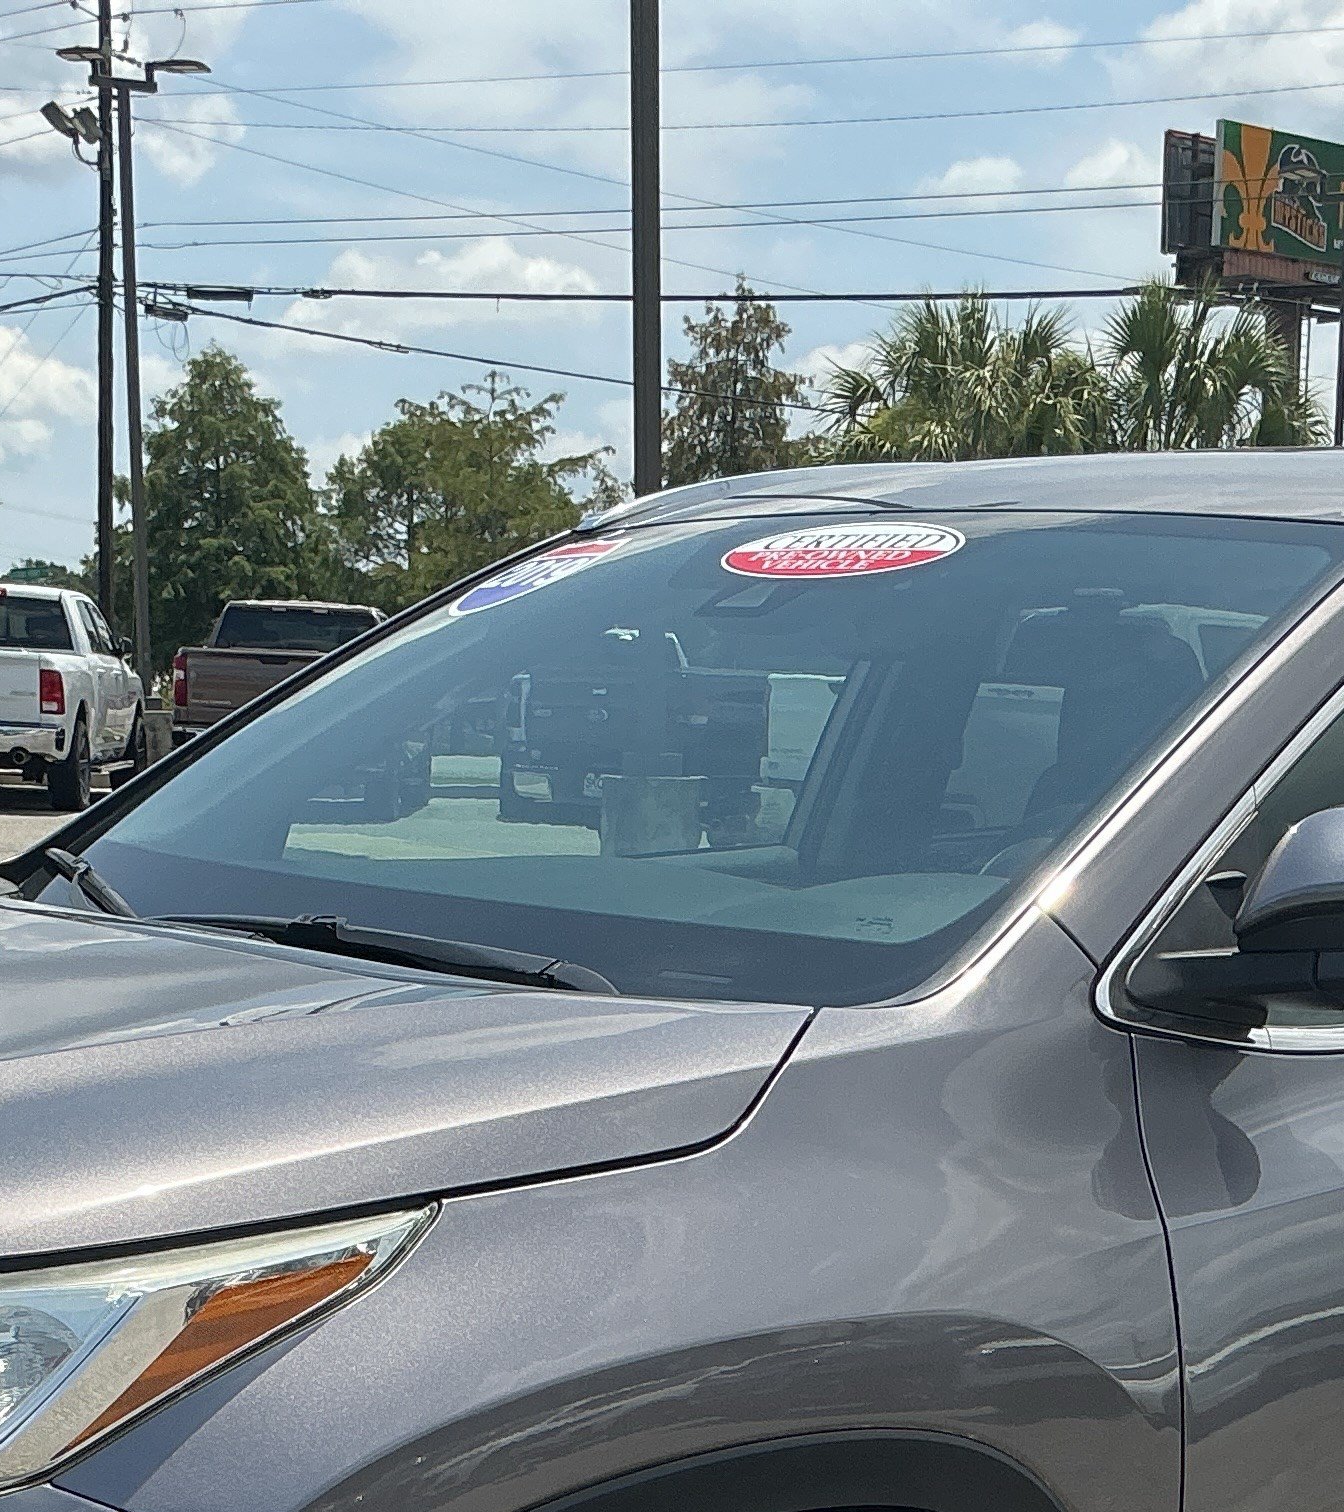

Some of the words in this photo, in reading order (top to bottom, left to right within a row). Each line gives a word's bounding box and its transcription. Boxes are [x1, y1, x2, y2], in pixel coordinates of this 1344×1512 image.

[763, 533, 947, 550] CERTIFIED
[747, 550, 912, 562] PRE-OWNED
[760, 559, 875, 571] VEHICLE
